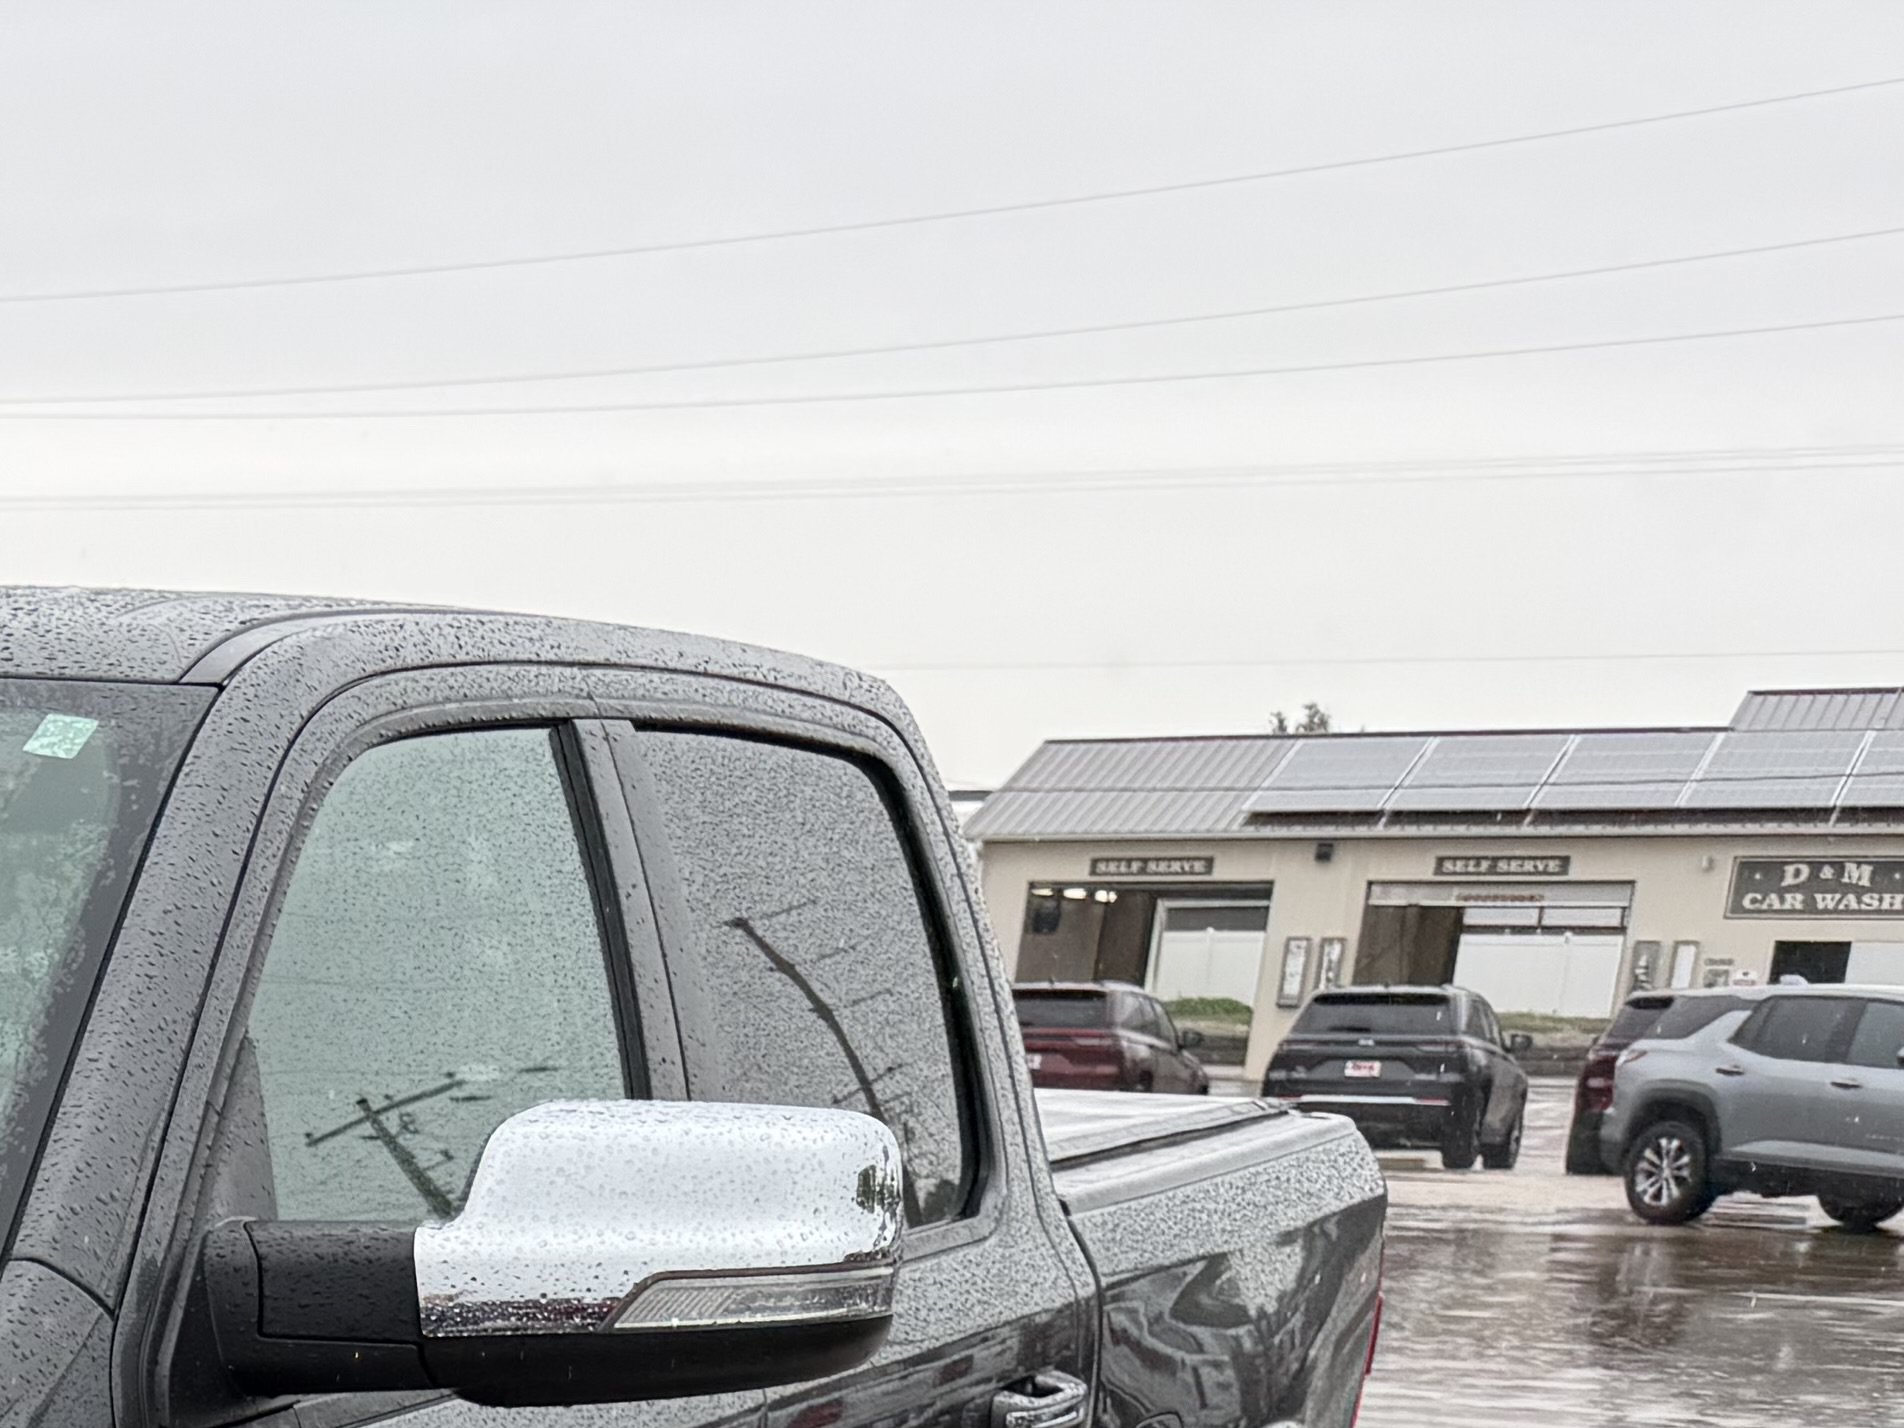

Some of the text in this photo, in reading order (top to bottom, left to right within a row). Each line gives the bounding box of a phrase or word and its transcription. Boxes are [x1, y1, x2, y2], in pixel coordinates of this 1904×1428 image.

[1095, 859, 1206, 874] SELF SERVE
[1442, 859, 1563, 873] SELF SERVE
[1780, 862, 1874, 887] D & M
[1742, 893, 1904, 910] CAR WASH
